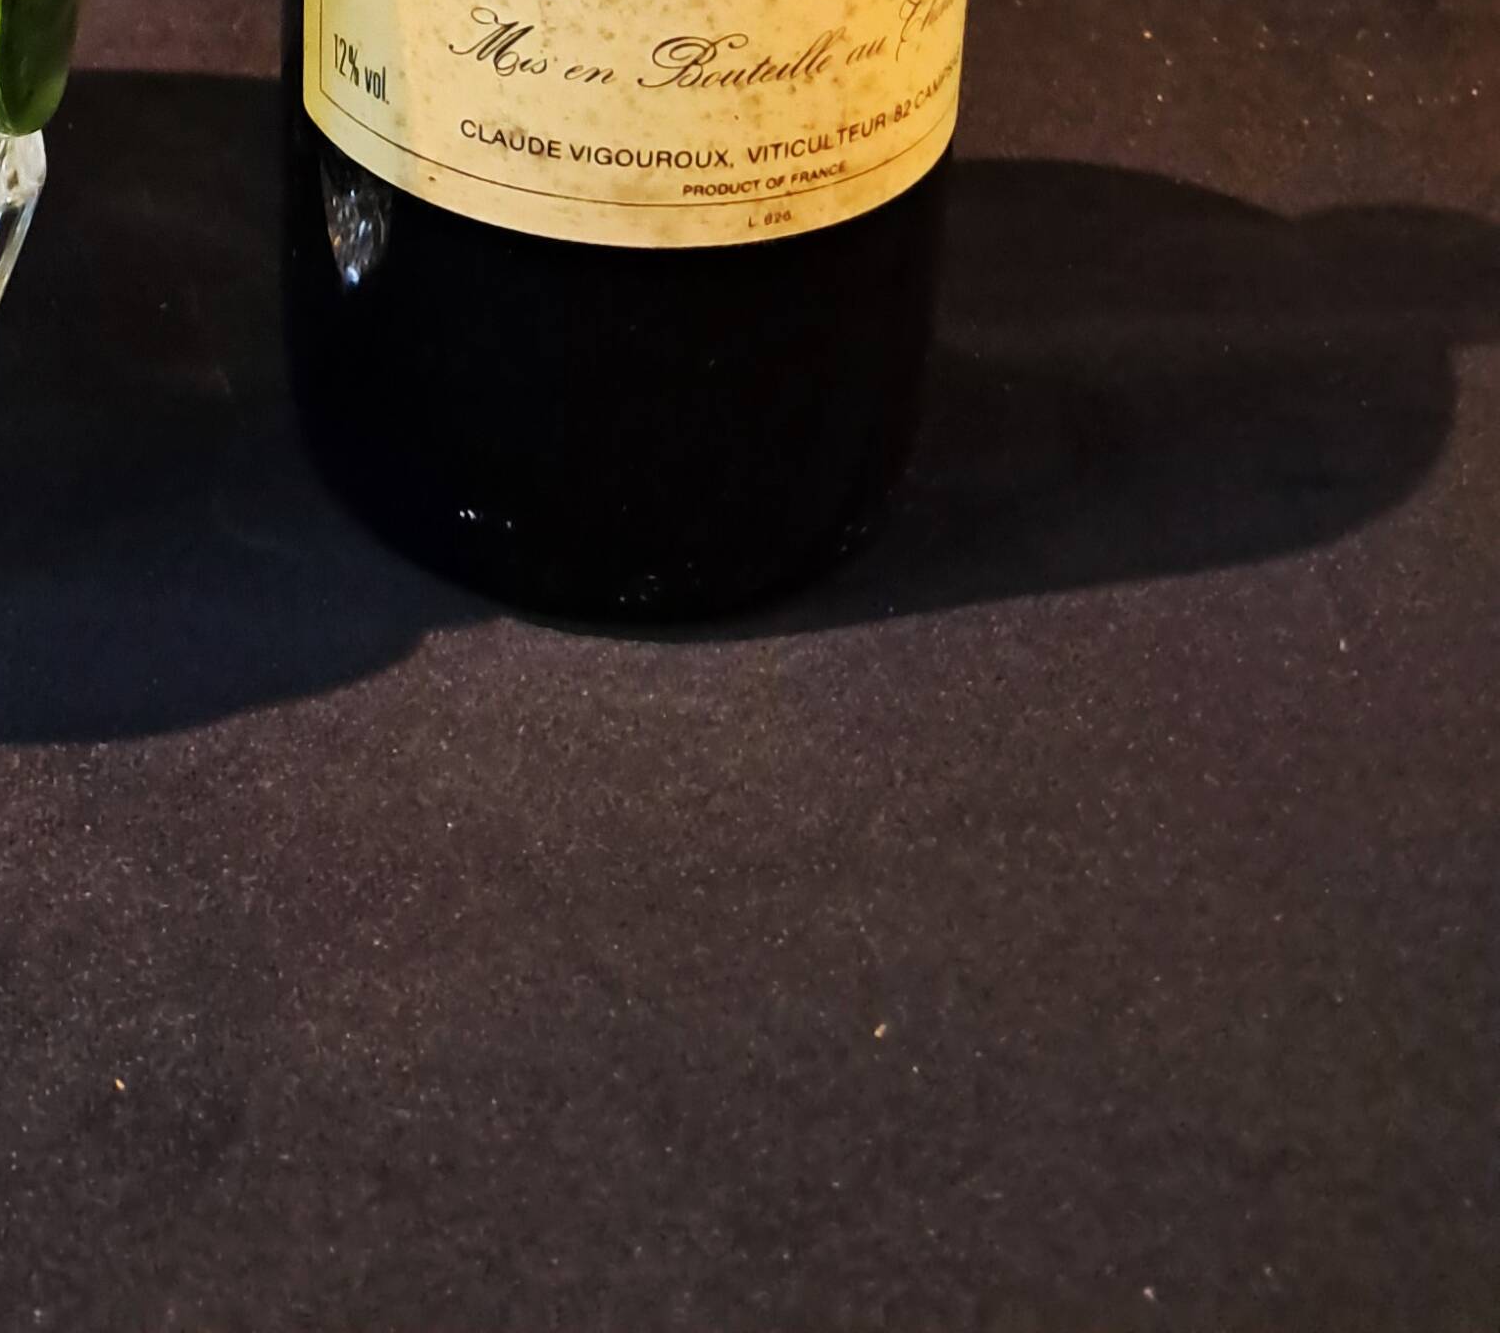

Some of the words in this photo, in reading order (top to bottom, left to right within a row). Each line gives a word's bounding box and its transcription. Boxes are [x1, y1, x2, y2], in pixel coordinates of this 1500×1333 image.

[333, 33, 360, 87] 12%
[448, 6, 548, 77] Mis
[564, 64, 615, 84] en
[460, 119, 562, 159] CLAUDE
[747, 112, 887, 165] VITICULTEUR
[682, 179, 760, 197] PRODUCT
[765, 175, 786, 191] OF
[790, 160, 848, 186] FRANCE
